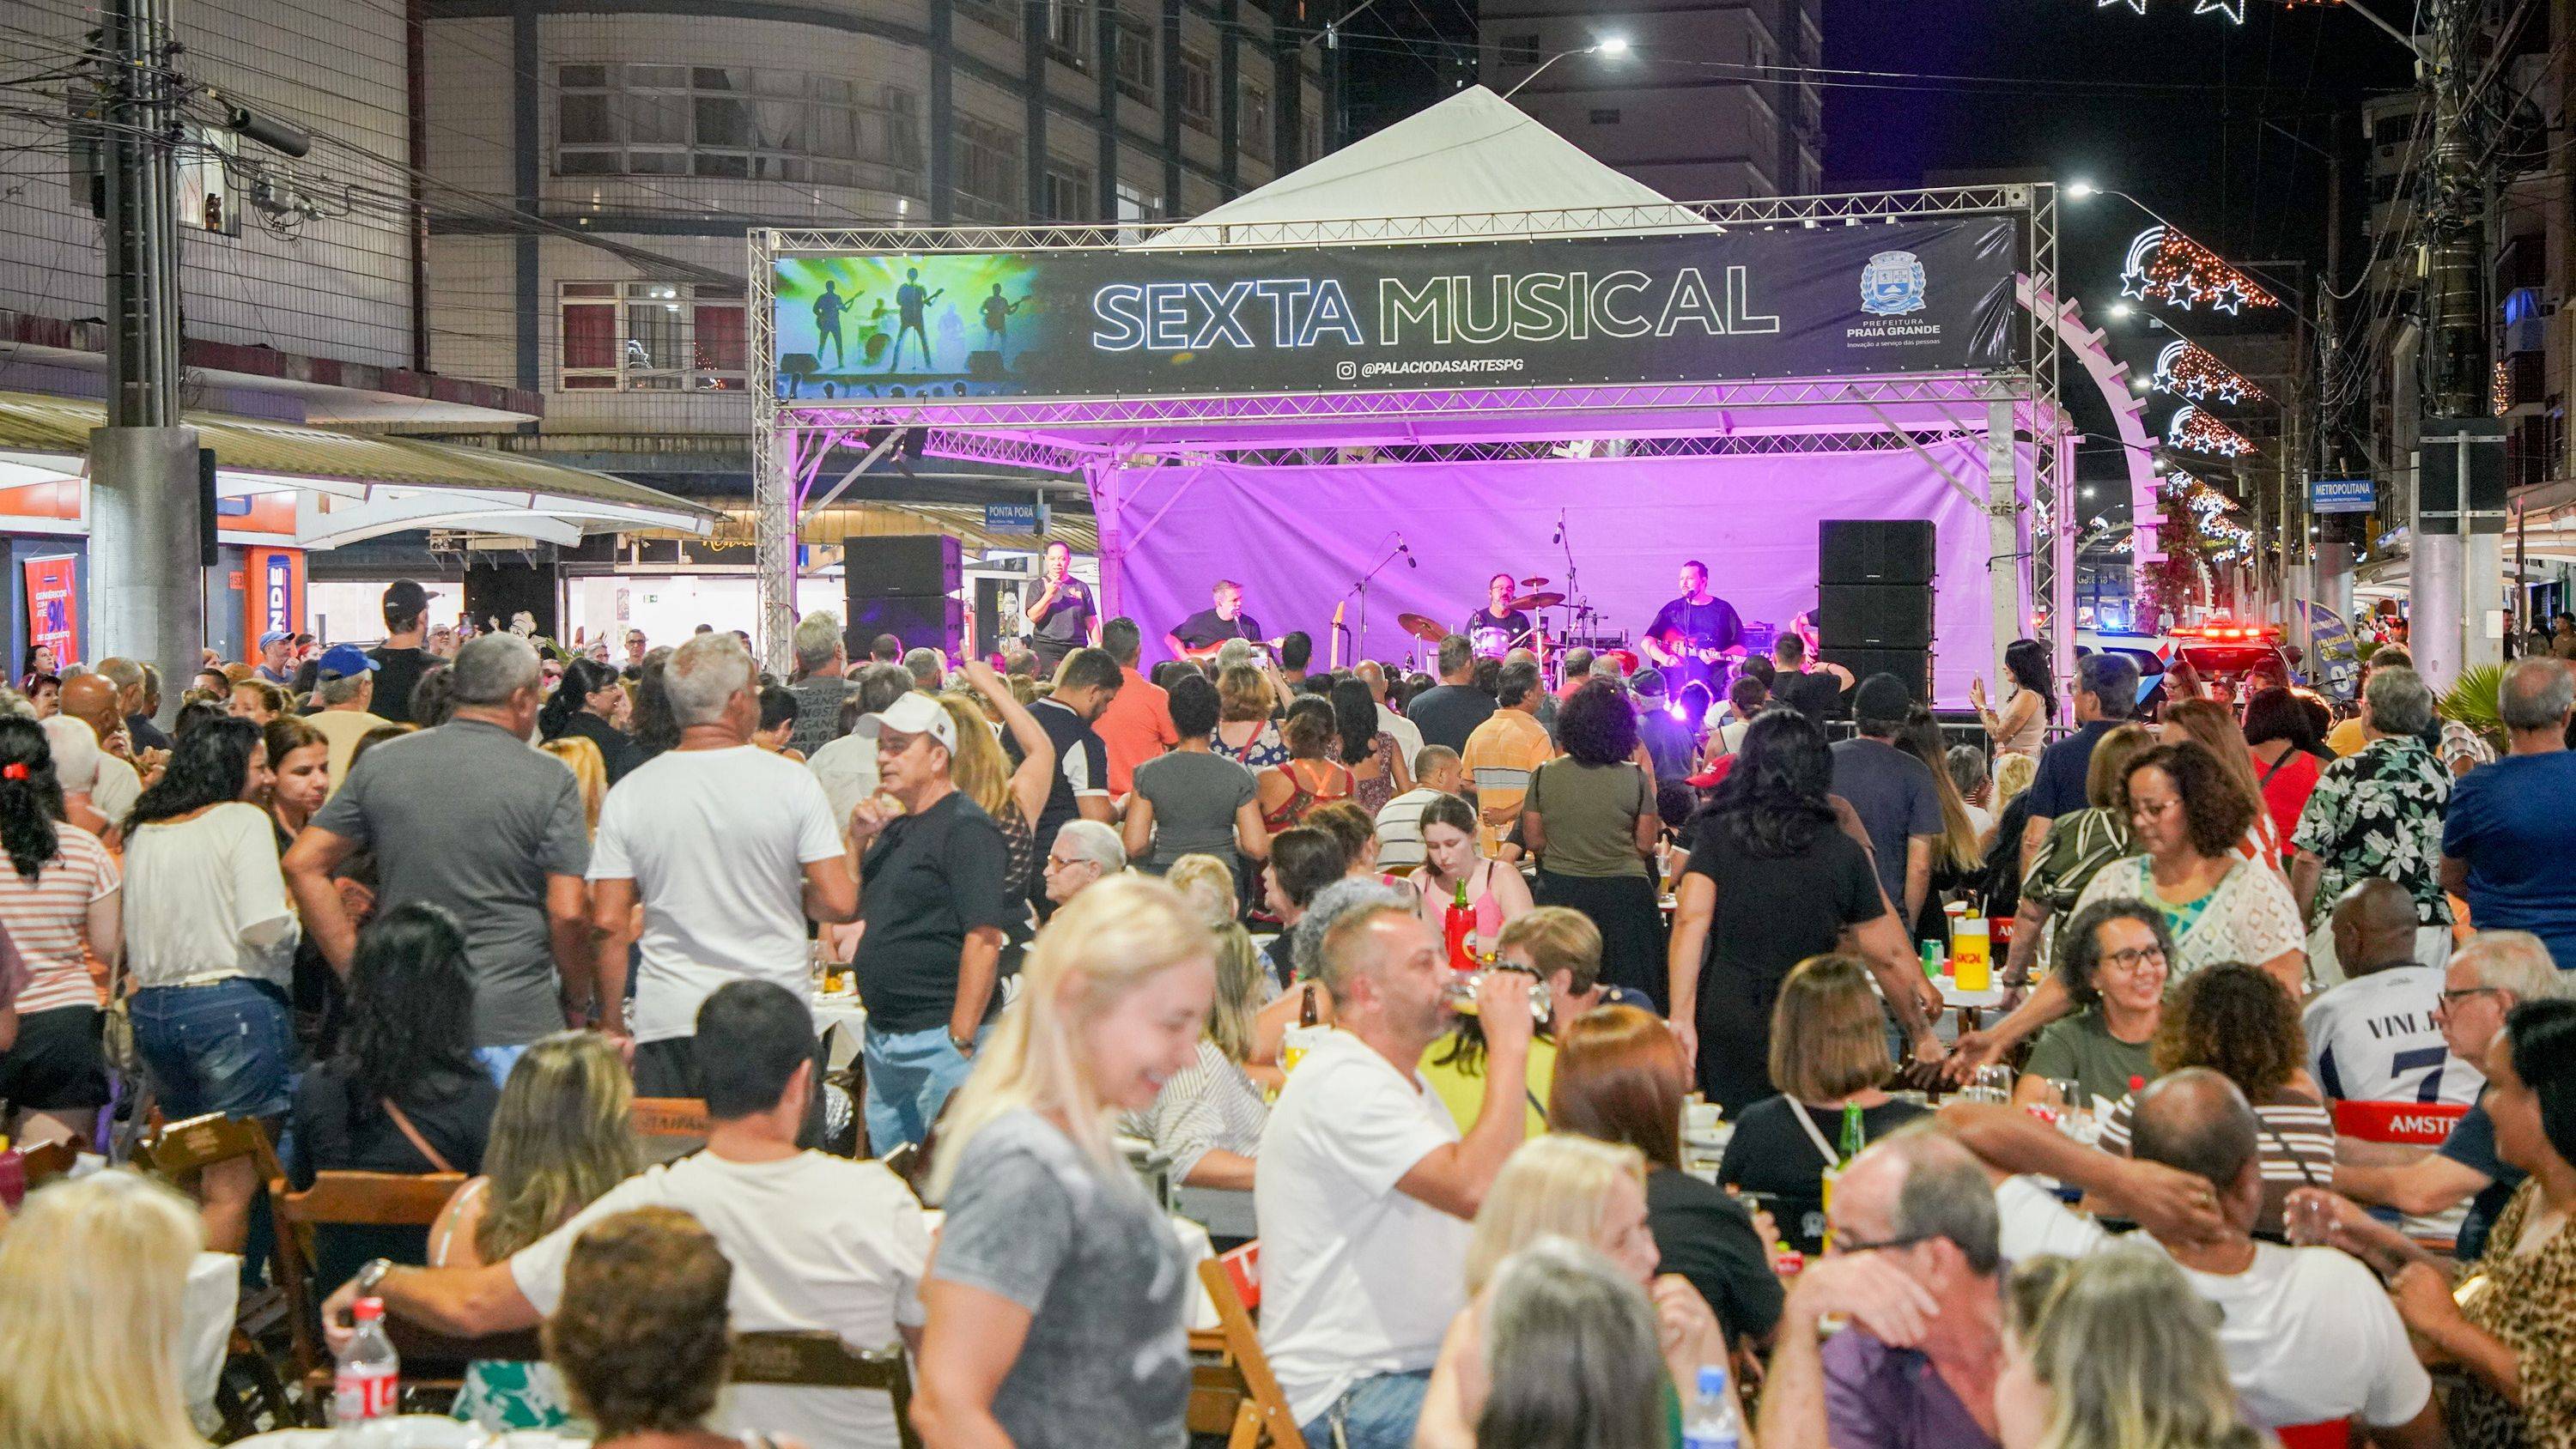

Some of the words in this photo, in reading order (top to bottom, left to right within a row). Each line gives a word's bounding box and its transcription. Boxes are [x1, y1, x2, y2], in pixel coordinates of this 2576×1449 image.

[1093, 279, 1364, 352] SEXTA
[1379, 266, 1780, 346] MUSICAL
[1847, 328, 1886, 337] PRAIA
[1886, 324, 1941, 336] GRANDE
[1862, 318, 1924, 327] PREFEITURA
[1361, 358, 1524, 379] @PALACIODASARTESPG
[2315, 482, 2370, 495] METROPOLITANA
[989, 506, 1013, 517] PONTA
[2367, 1013, 2416, 1039] VINI
[2391, 1046, 2450, 1105] 7
